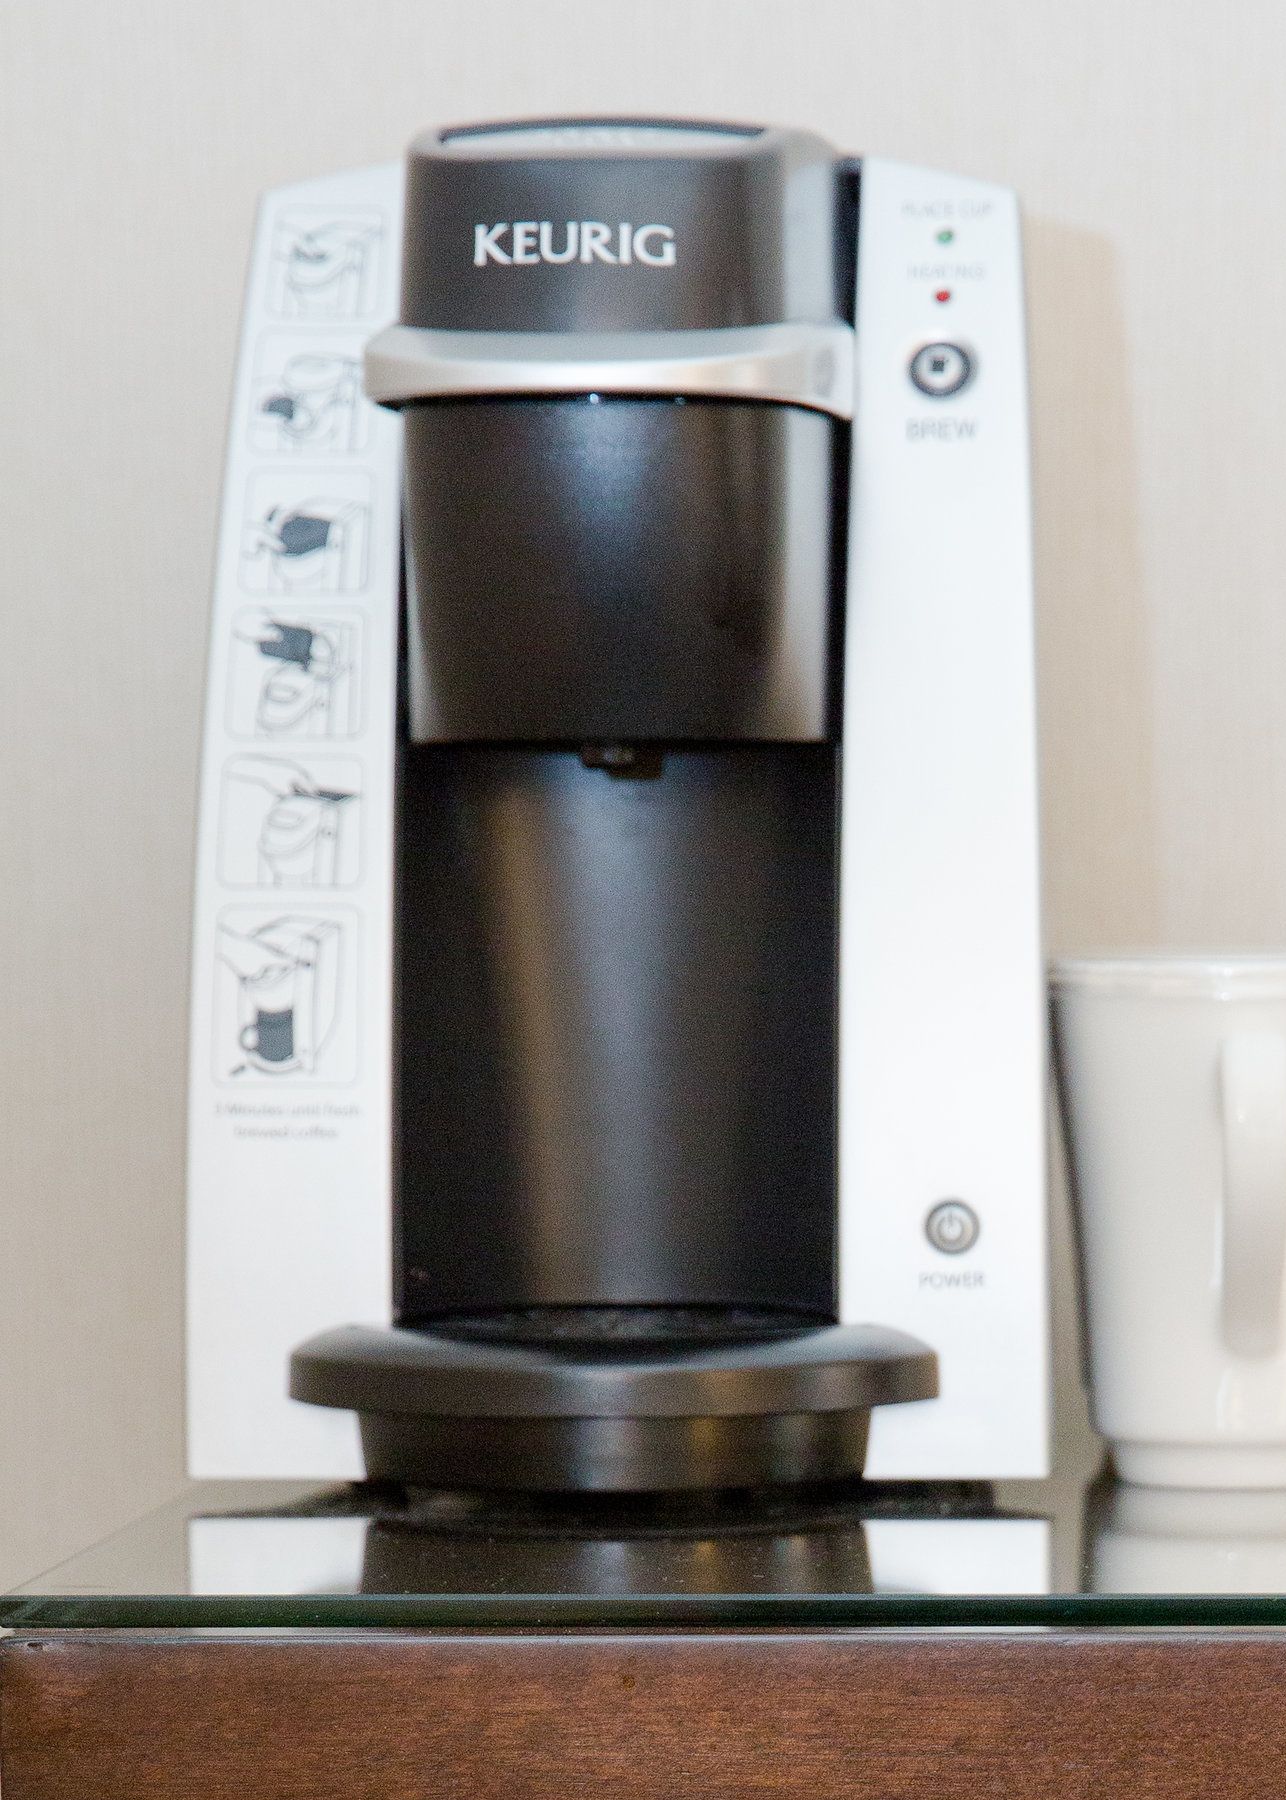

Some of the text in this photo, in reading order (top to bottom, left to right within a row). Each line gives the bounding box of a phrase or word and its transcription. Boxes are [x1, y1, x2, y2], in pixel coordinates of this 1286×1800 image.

[473, 221, 676, 266] KEURIG
[905, 418, 976, 441] BREW
[918, 1270, 985, 1289] POWER
